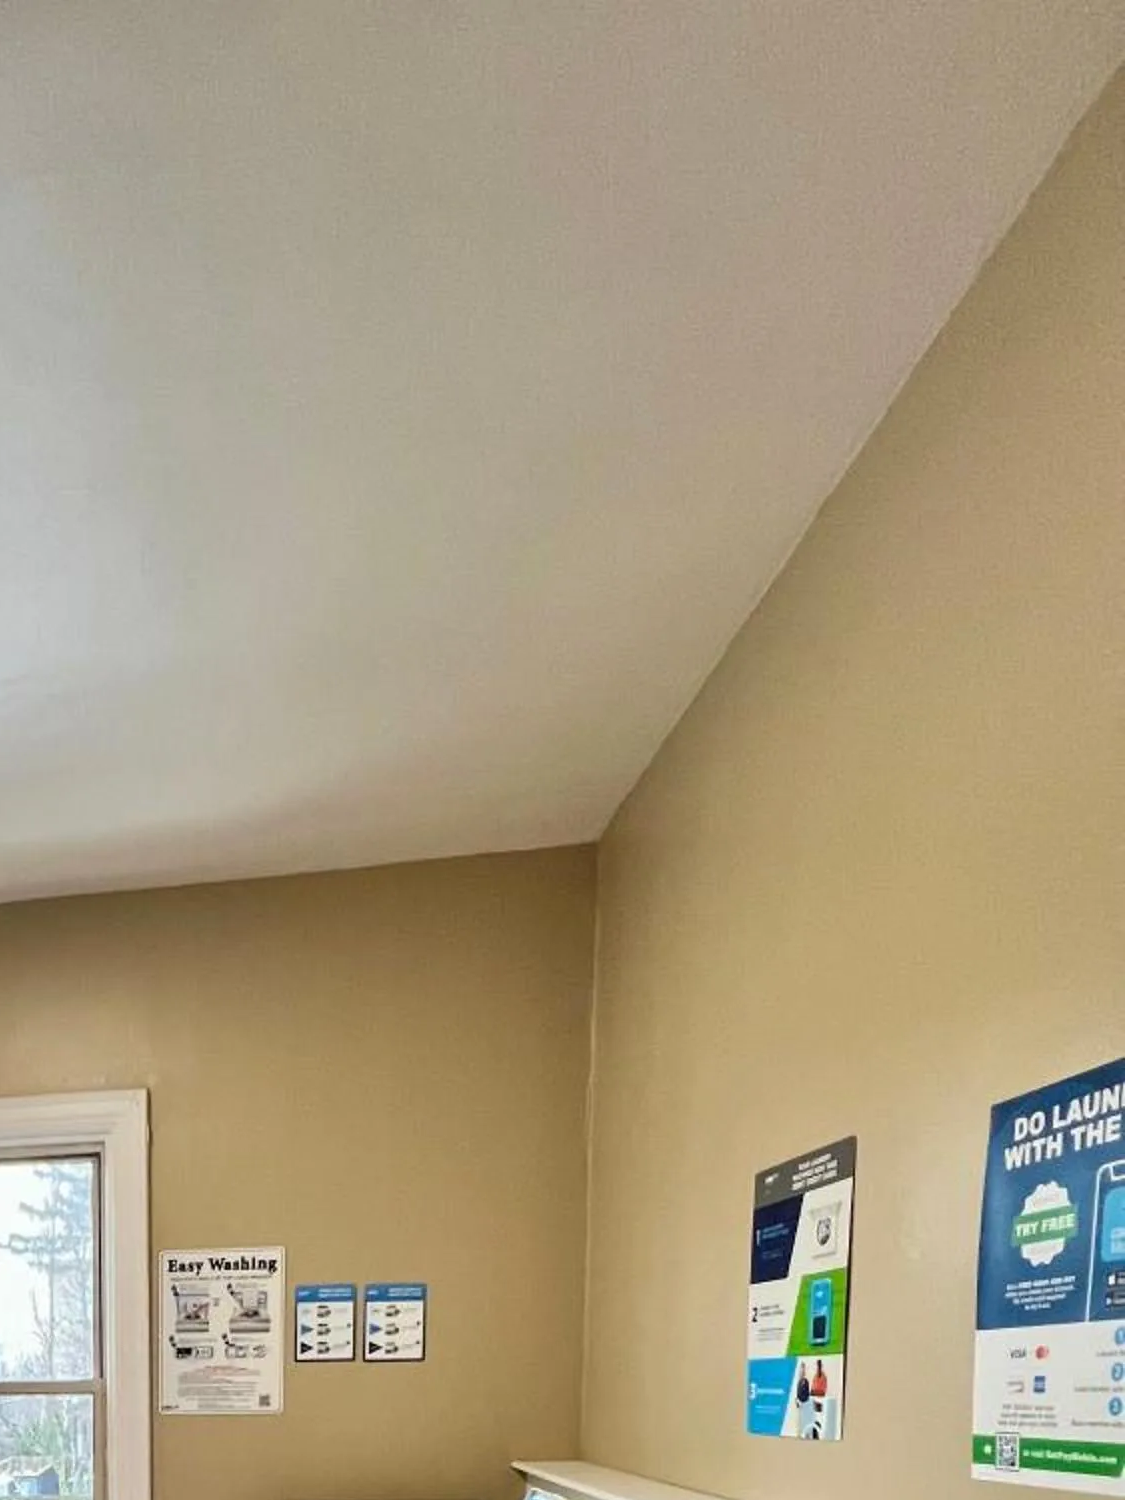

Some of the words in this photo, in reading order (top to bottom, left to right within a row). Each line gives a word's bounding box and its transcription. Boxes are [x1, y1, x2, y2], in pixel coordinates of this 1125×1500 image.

[1014, 1111, 1045, 1141] DO
[1004, 1132, 1063, 1171] WITH
[1071, 1114, 1122, 1152] THE
[1016, 1220, 1039, 1237] TRY
[1040, 1213, 1075, 1233] FREE
[168, 1259, 204, 1276] Easy
[208, 1255, 278, 1275] Washing
